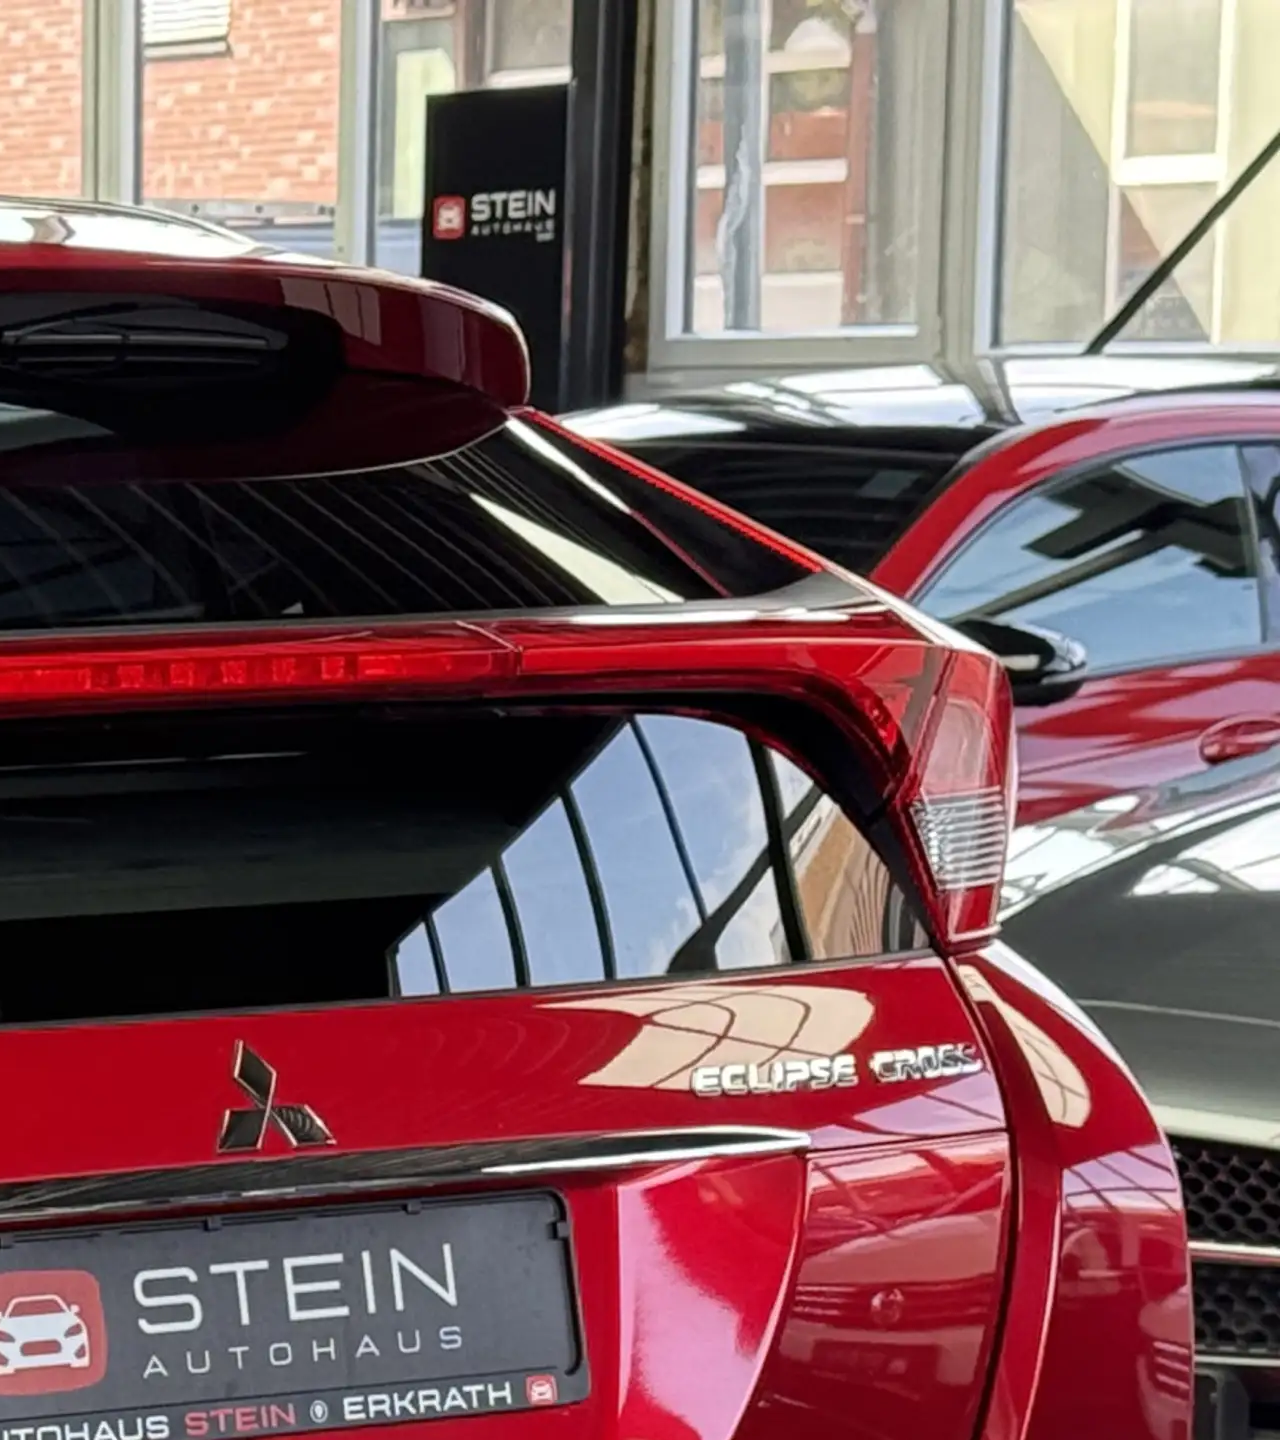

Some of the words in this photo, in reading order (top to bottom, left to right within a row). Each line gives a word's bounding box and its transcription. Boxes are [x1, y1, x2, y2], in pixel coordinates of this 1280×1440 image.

[471, 188, 556, 222] STEIN
[691, 1053, 859, 1097] ECLIPSE
[869, 1043, 983, 1083] CROSS
[132, 1242, 460, 1336] STEIN
[142, 1325, 464, 1379] AUTOHAUS
[184, 1402, 297, 1437] STEIN
[342, 1381, 513, 1422] ERKRATH
